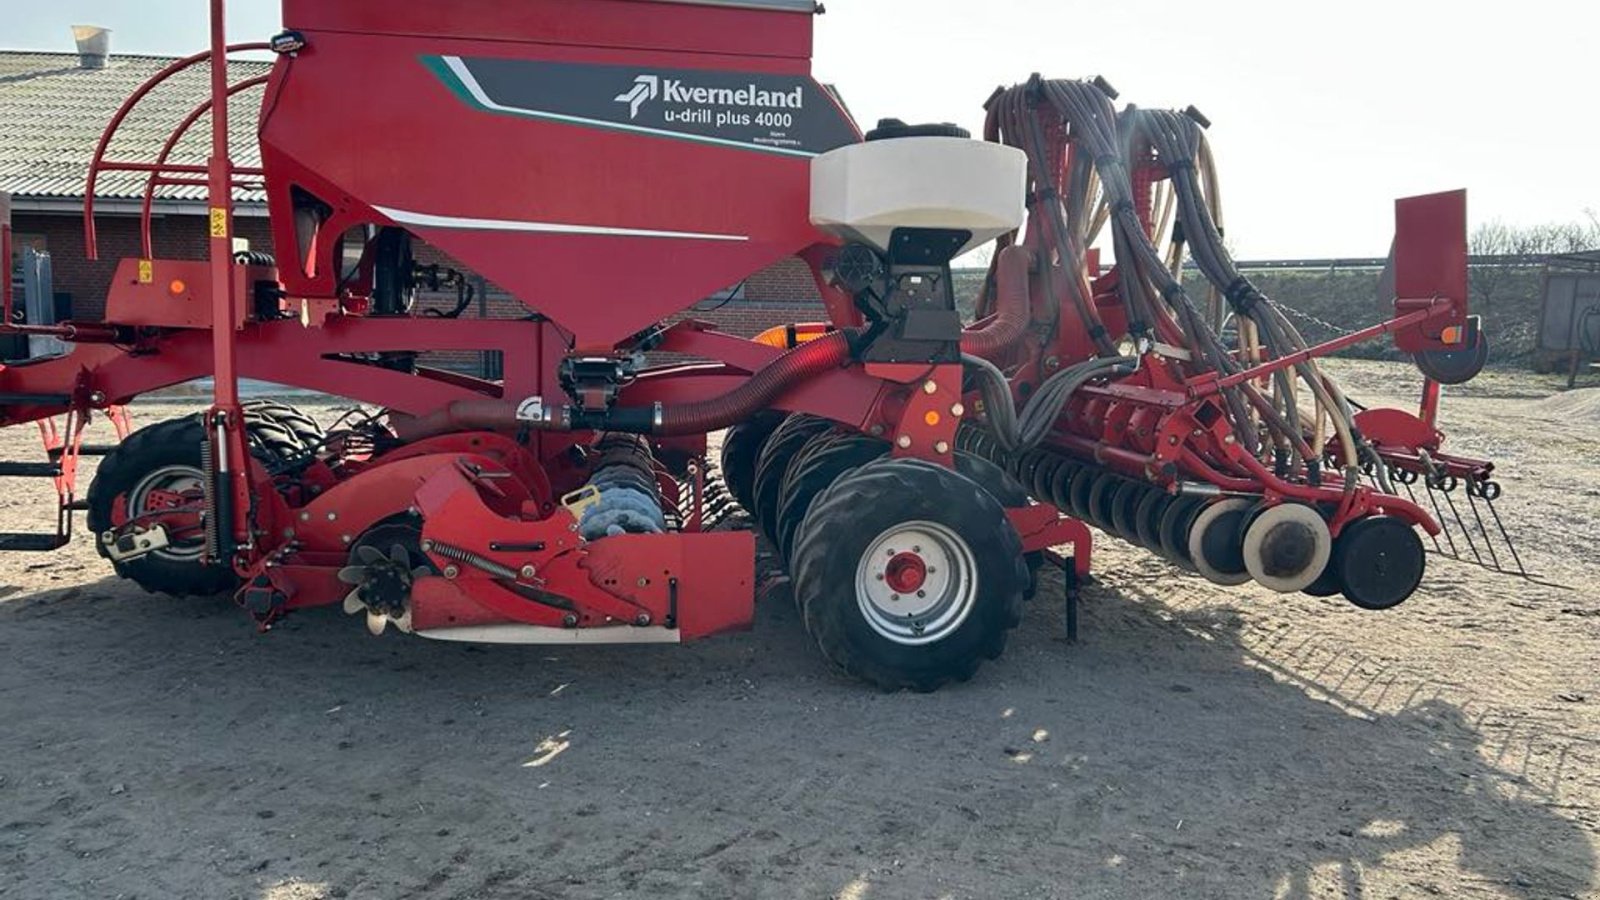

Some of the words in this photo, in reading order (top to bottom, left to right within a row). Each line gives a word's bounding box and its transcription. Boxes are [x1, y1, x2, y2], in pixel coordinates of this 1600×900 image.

[663, 79, 803, 109] Kverneland
[664, 108, 711, 124] u-drill
[716, 110, 751, 128] plus
[755, 112, 793, 128] 4000
